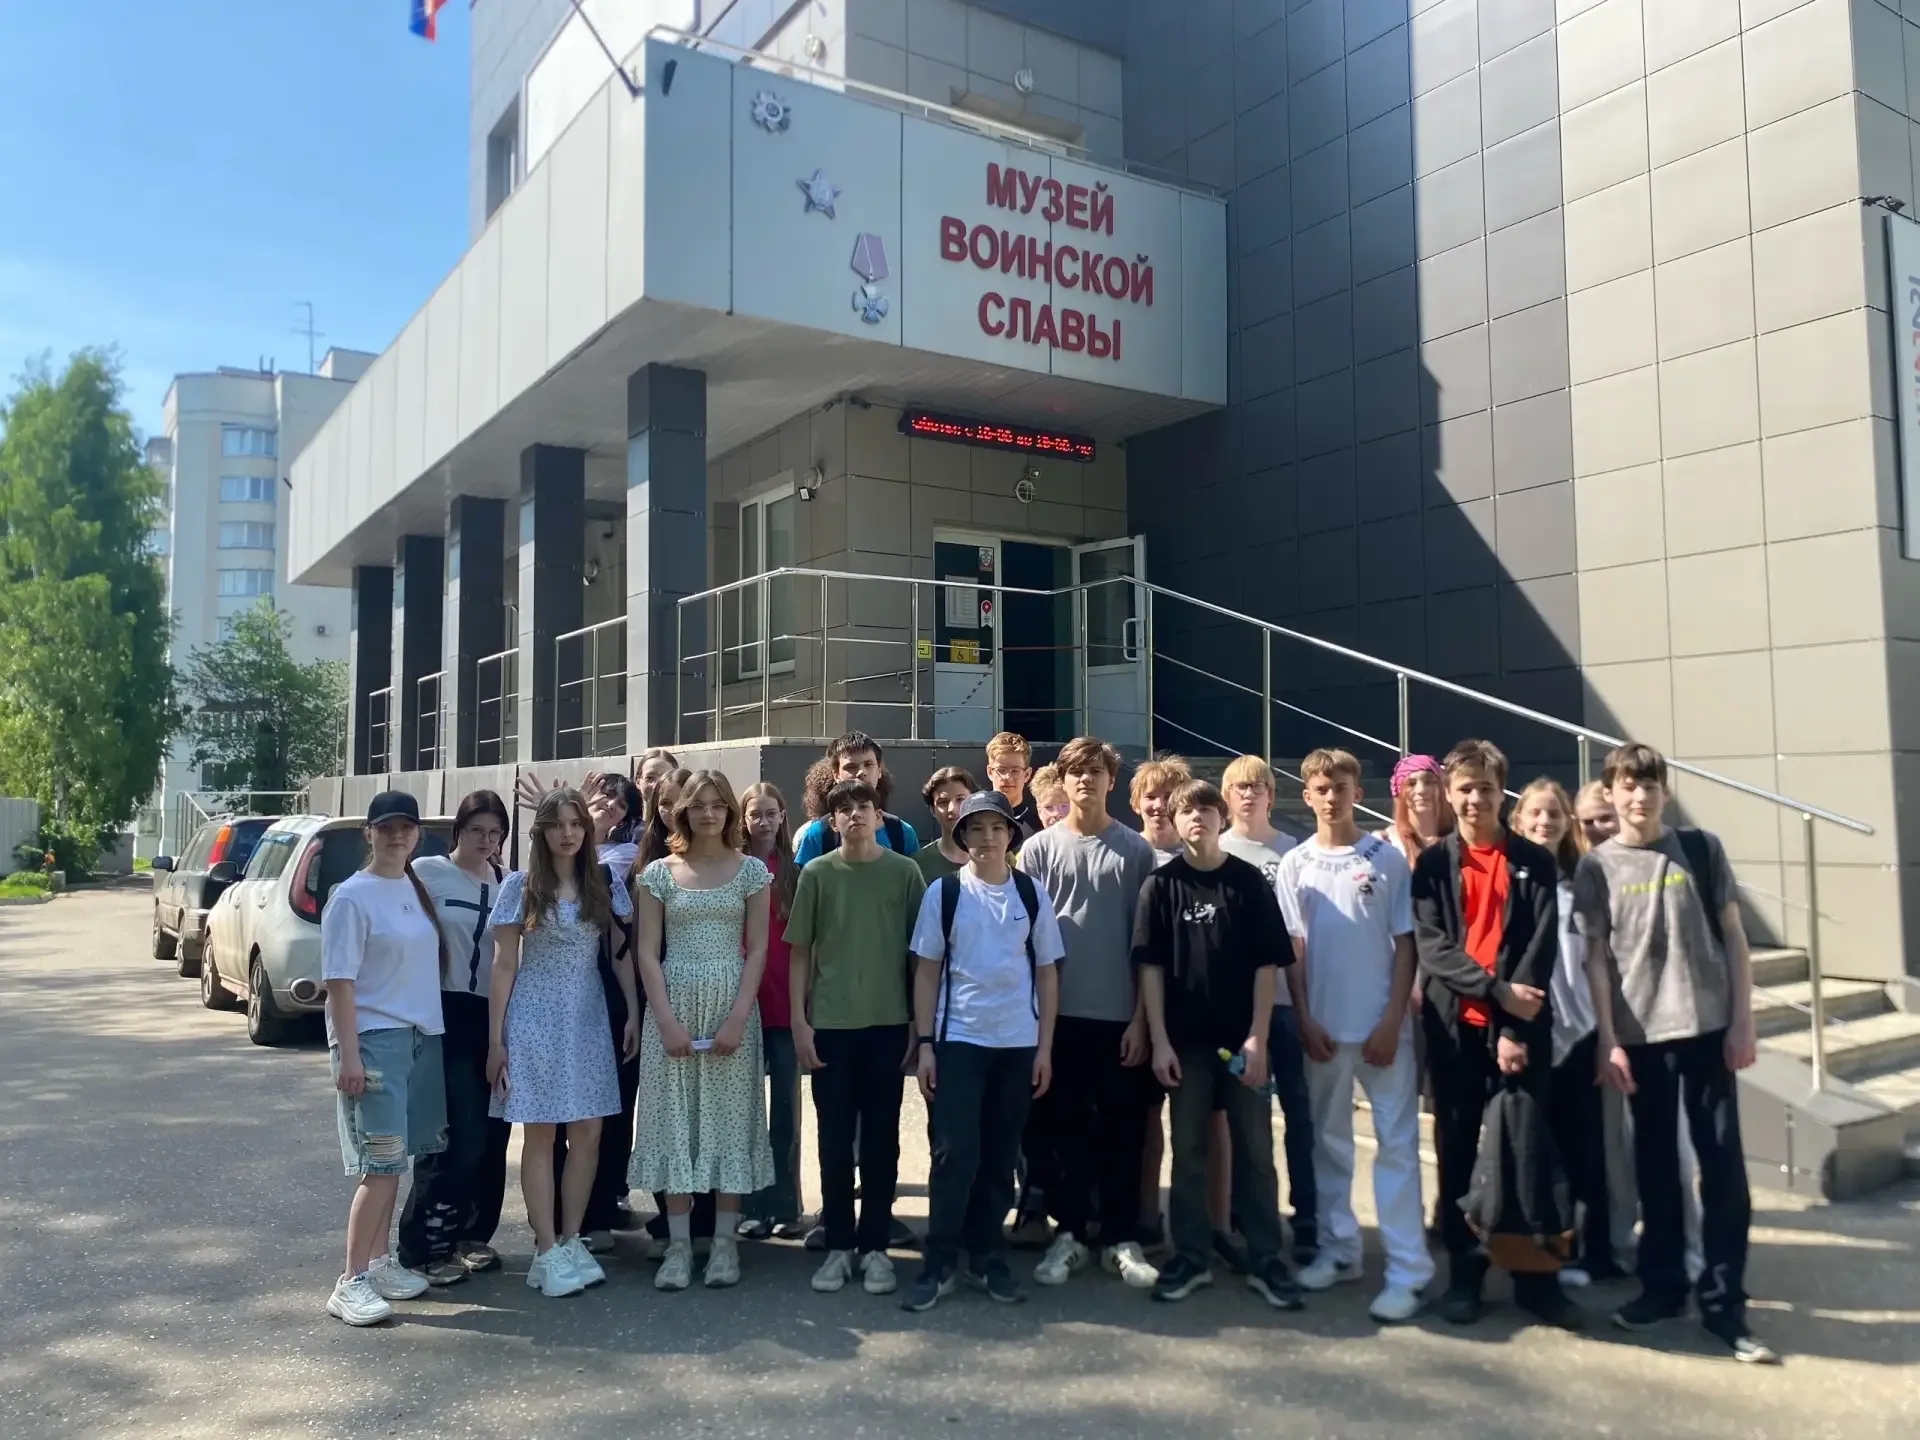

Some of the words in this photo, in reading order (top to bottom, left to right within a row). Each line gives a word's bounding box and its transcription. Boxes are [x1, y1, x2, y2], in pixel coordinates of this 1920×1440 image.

[986, 162, 1114, 236] МУЗЕЙ
[940, 215, 1154, 306] ВОИНСКОЙ
[978, 292, 1121, 361] СЛАВЫ
